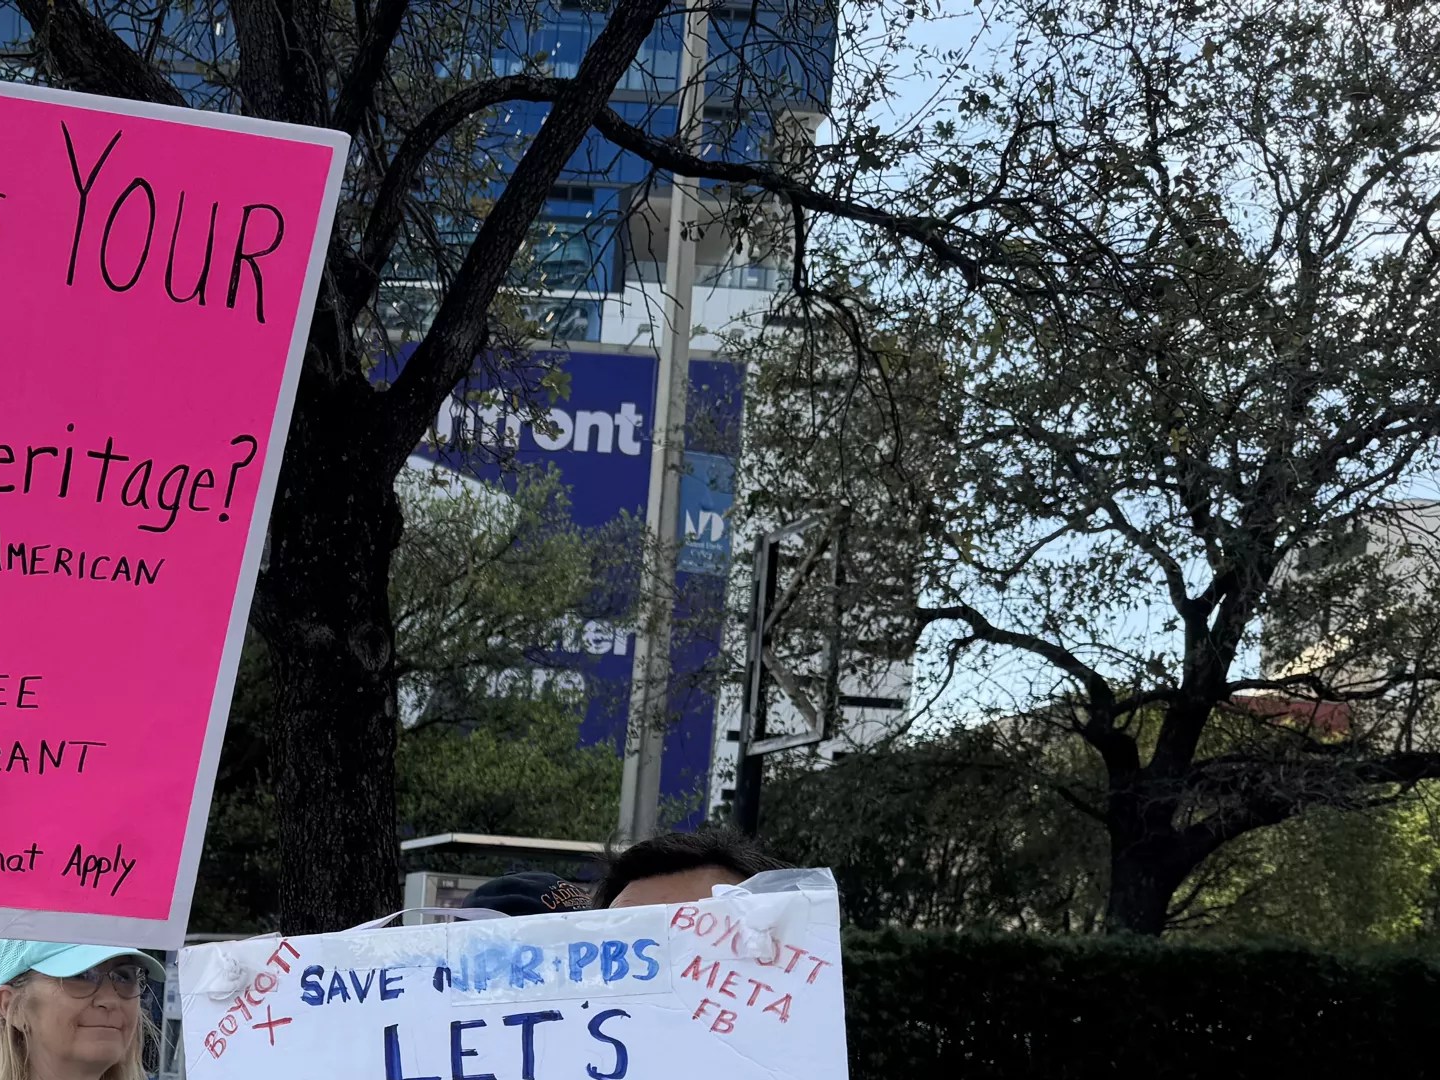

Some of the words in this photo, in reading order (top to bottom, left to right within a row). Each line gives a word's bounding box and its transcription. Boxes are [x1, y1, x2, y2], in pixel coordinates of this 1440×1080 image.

[60, 120, 284, 324] YOUR
[61, 843, 137, 897] Apply
[300, 964, 405, 1006] SAVE
[568, 937, 660, 984] PBS
[670, 906, 832, 984] BOYCOTT
[204, 938, 300, 1059] BOYCOTT
[681, 956, 793, 1023] META
[692, 998, 738, 1034] FB
